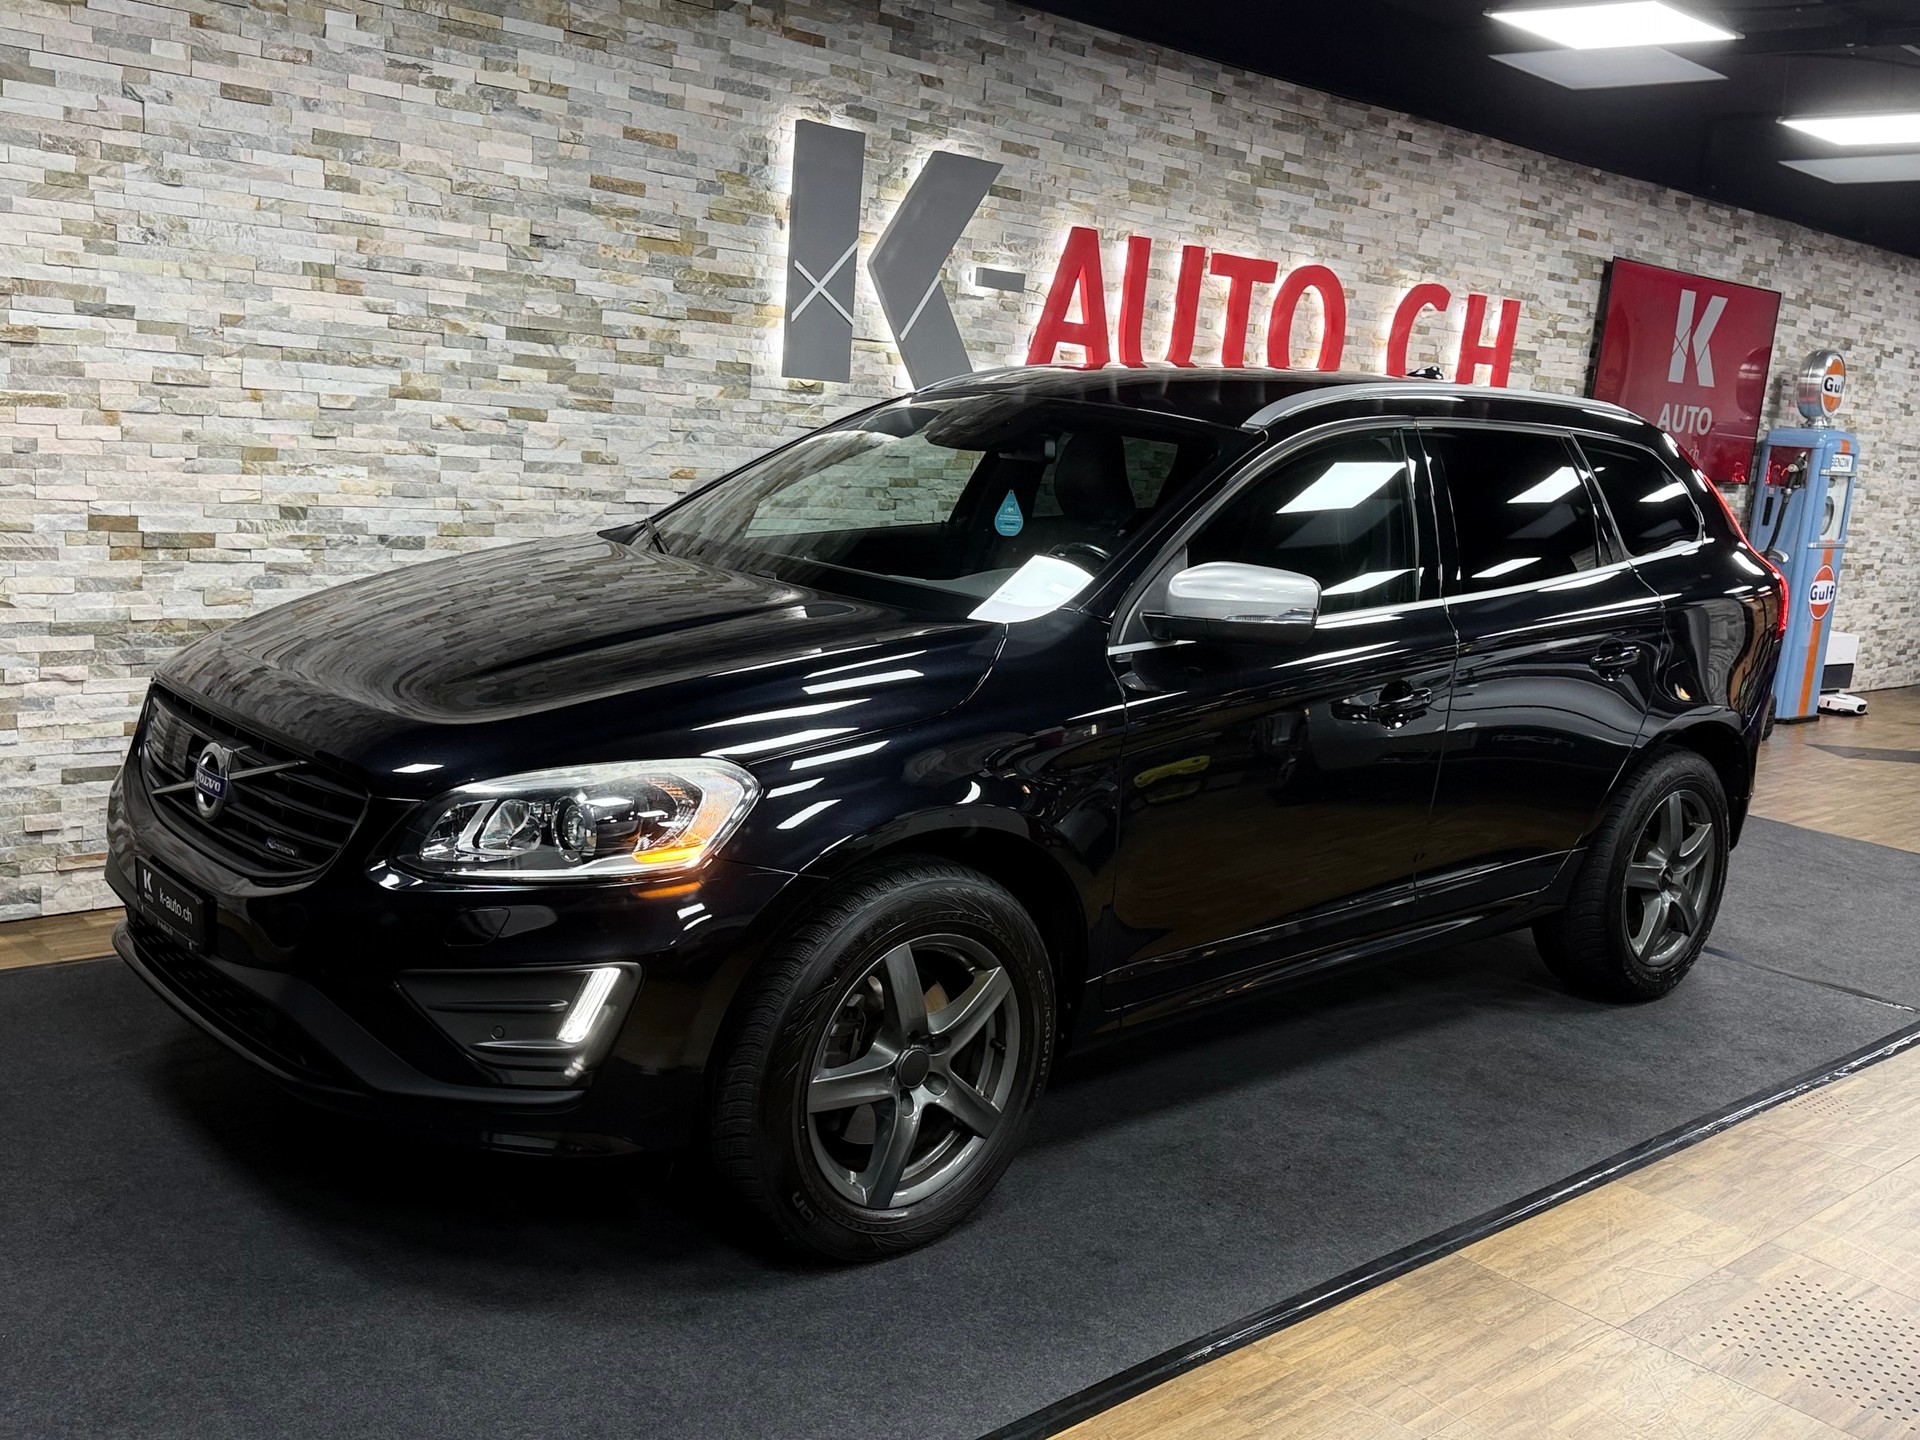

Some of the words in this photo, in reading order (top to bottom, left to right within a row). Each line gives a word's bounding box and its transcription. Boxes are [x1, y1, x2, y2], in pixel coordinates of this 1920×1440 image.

[1668, 288, 1729, 388] K
[1656, 403, 1713, 436] AUTO
[1810, 585, 1834, 600] Gulf
[196, 769, 221, 792] VOLVO
[143, 868, 153, 893] K
[160, 887, 193, 925] k-auto.ch
